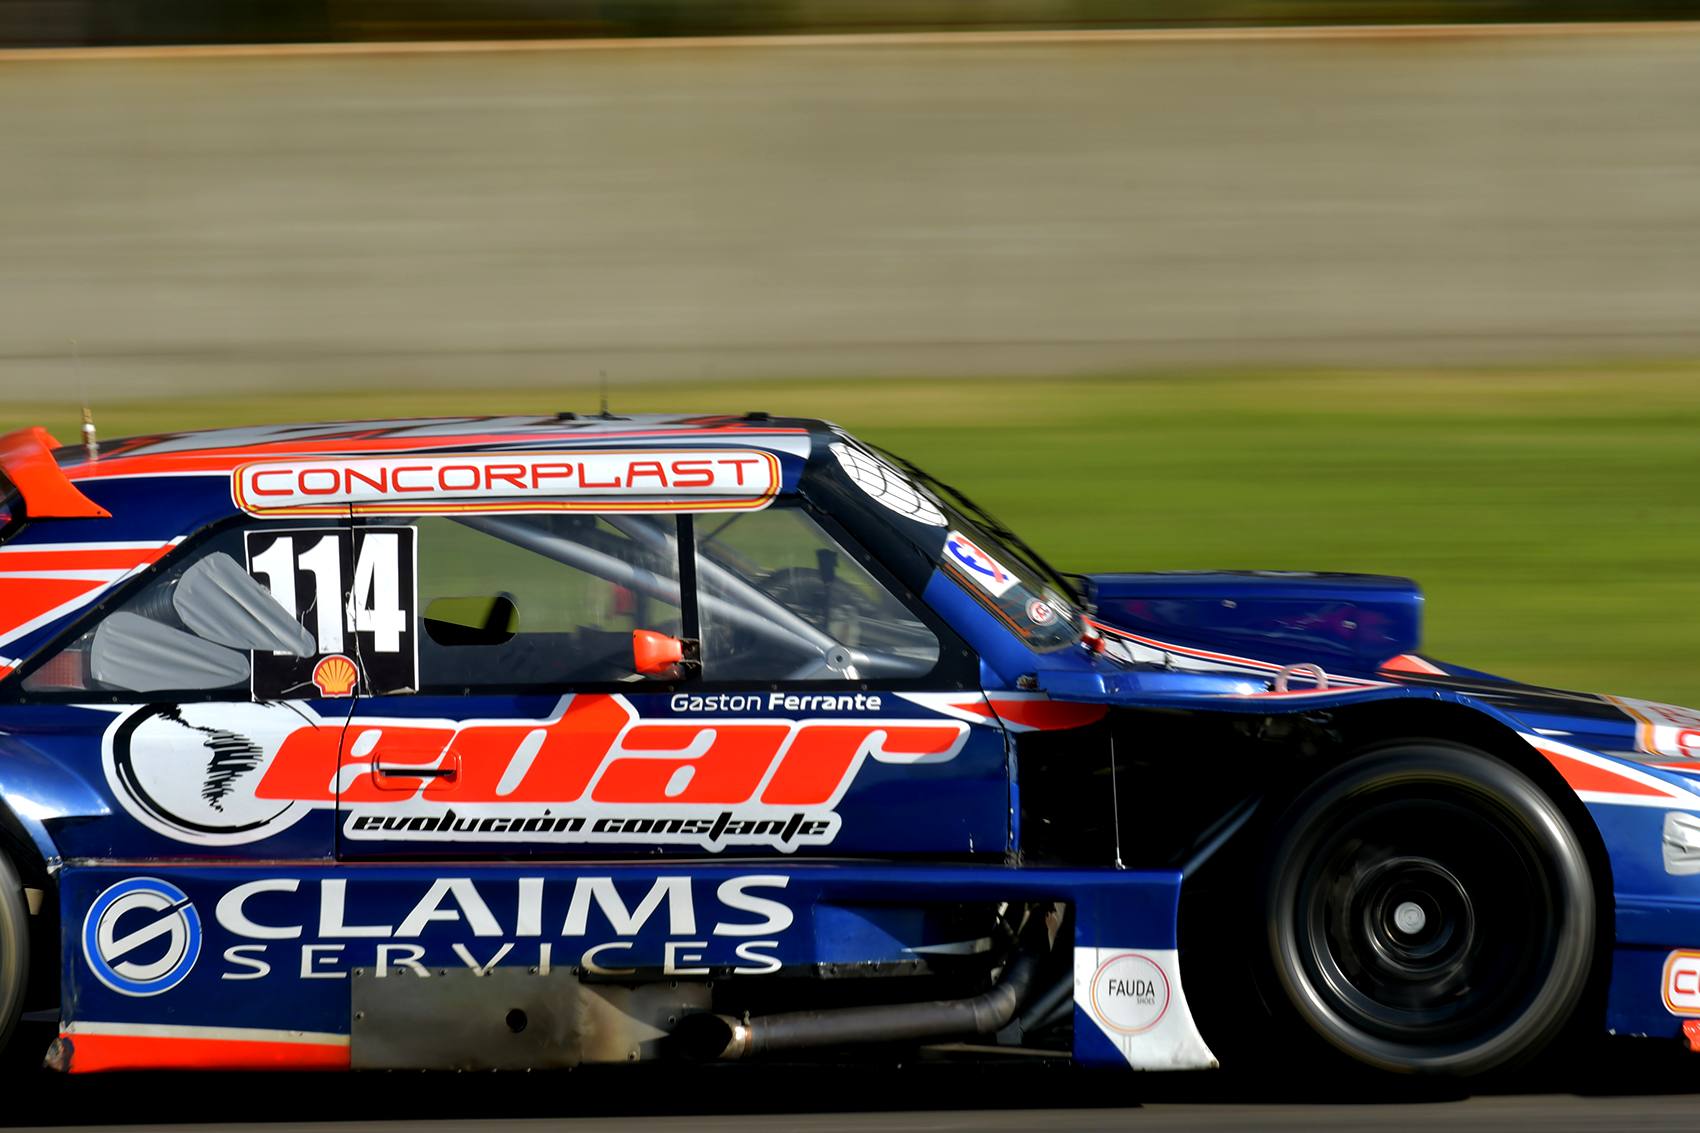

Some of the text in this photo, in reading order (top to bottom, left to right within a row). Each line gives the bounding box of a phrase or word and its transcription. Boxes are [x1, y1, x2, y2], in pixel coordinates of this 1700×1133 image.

[251, 459, 760, 496] CONCORPLAST
[252, 533, 406, 656] 114
[671, 693, 881, 713] Gaston Ferrante
[352, 808, 831, 843] evolución constante
[215, 876, 794, 940] CLAIMS
[221, 941, 783, 979] SERVICES
[1108, 979, 1155, 997] FAUDA
